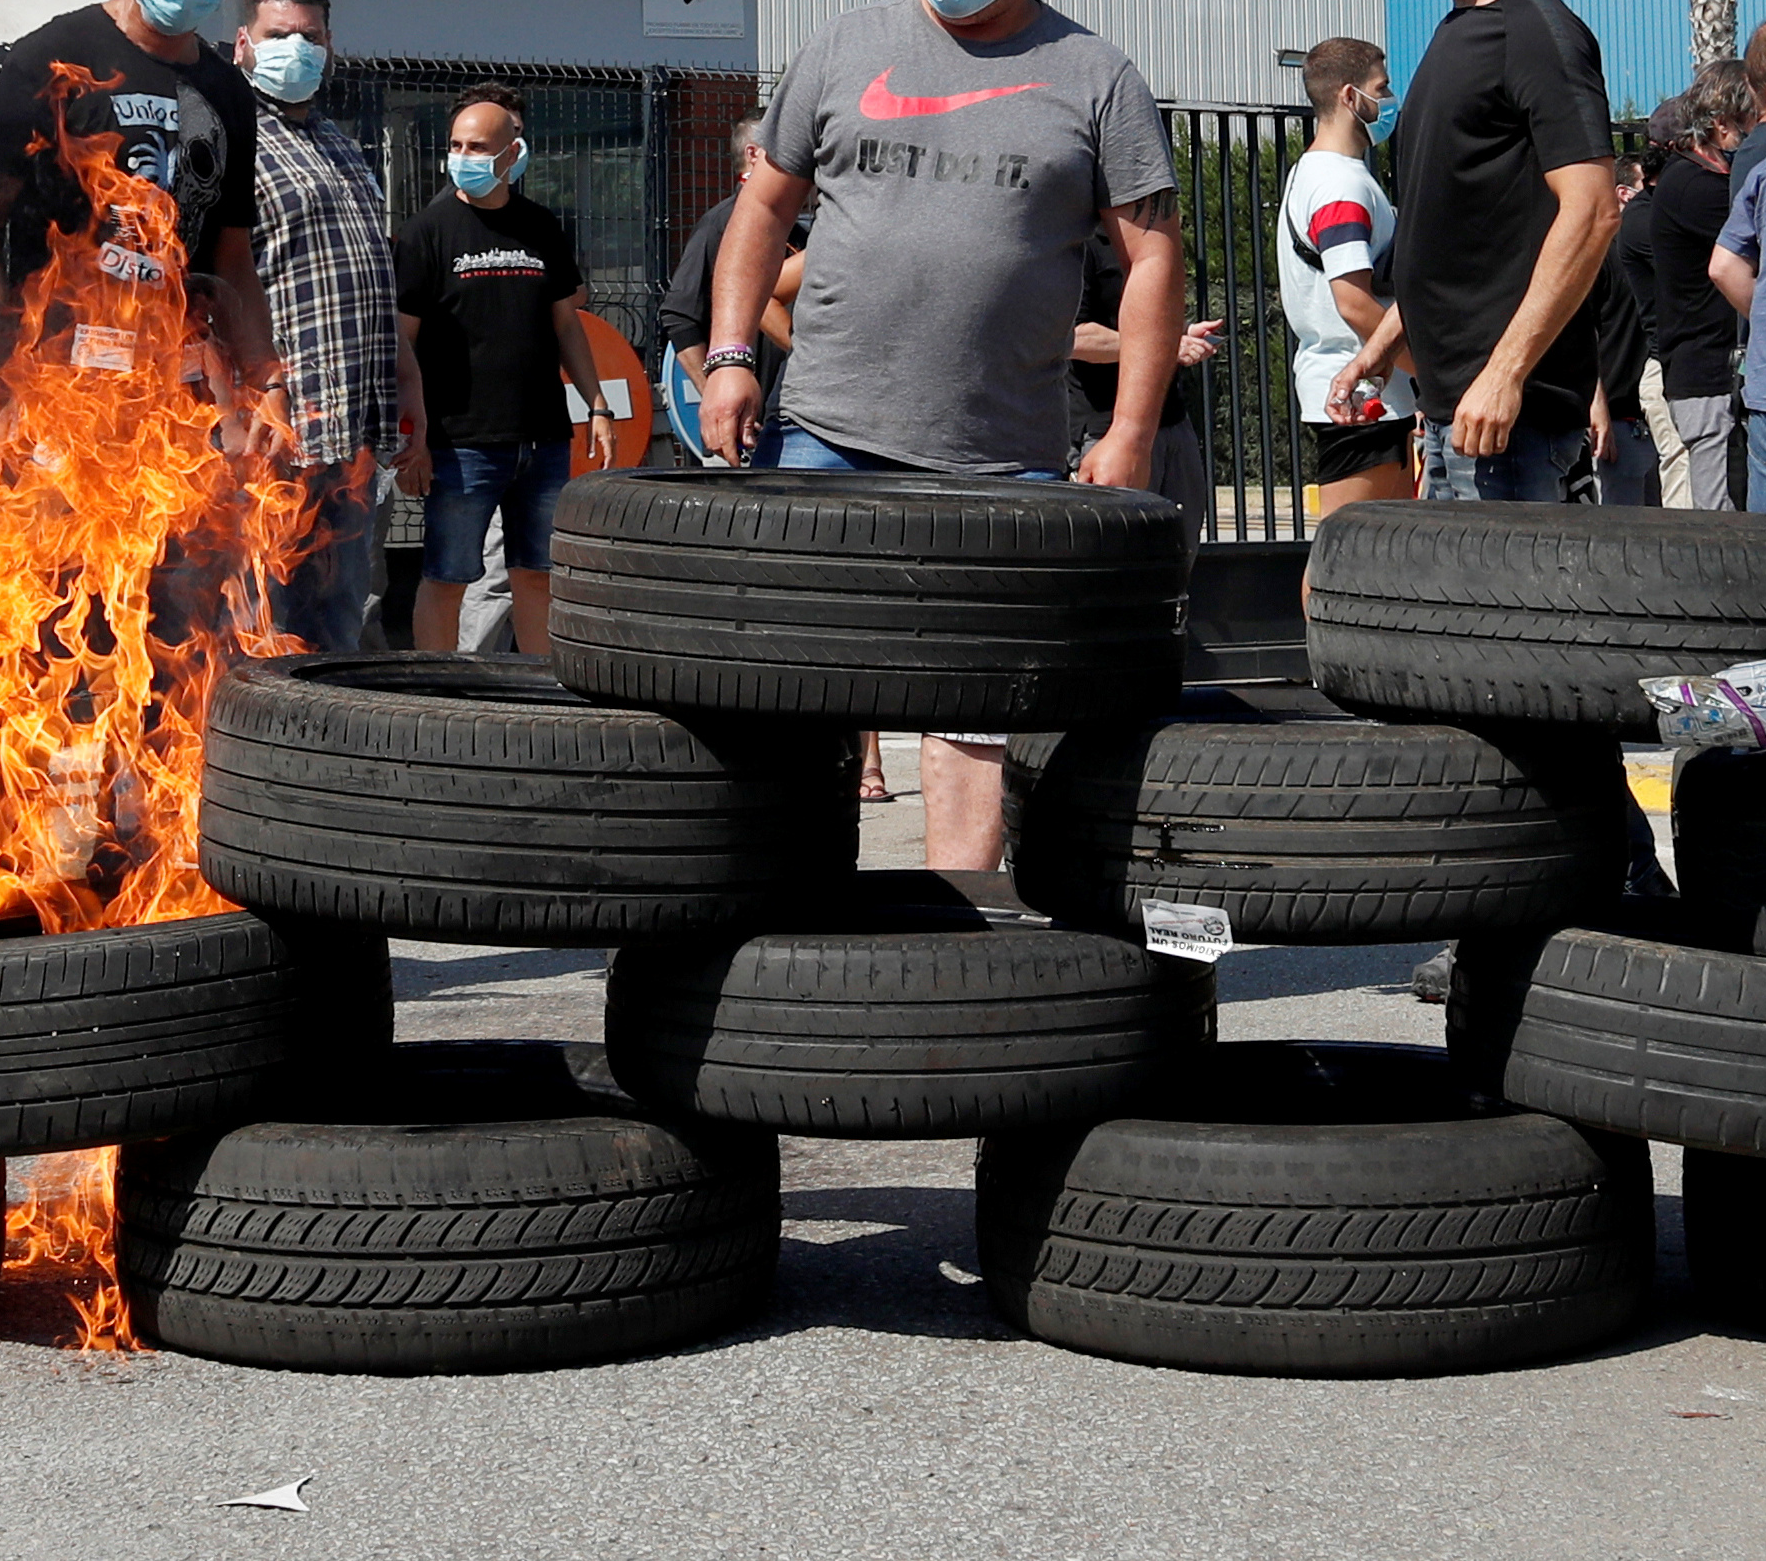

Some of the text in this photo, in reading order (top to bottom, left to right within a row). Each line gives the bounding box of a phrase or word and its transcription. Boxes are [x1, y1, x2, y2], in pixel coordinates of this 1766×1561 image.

[856, 137, 1030, 189] JUST DO IT.
[1148, 926, 1229, 946] FUTURO REAL
[1151, 937, 1224, 958] EXIGIMOS UN
